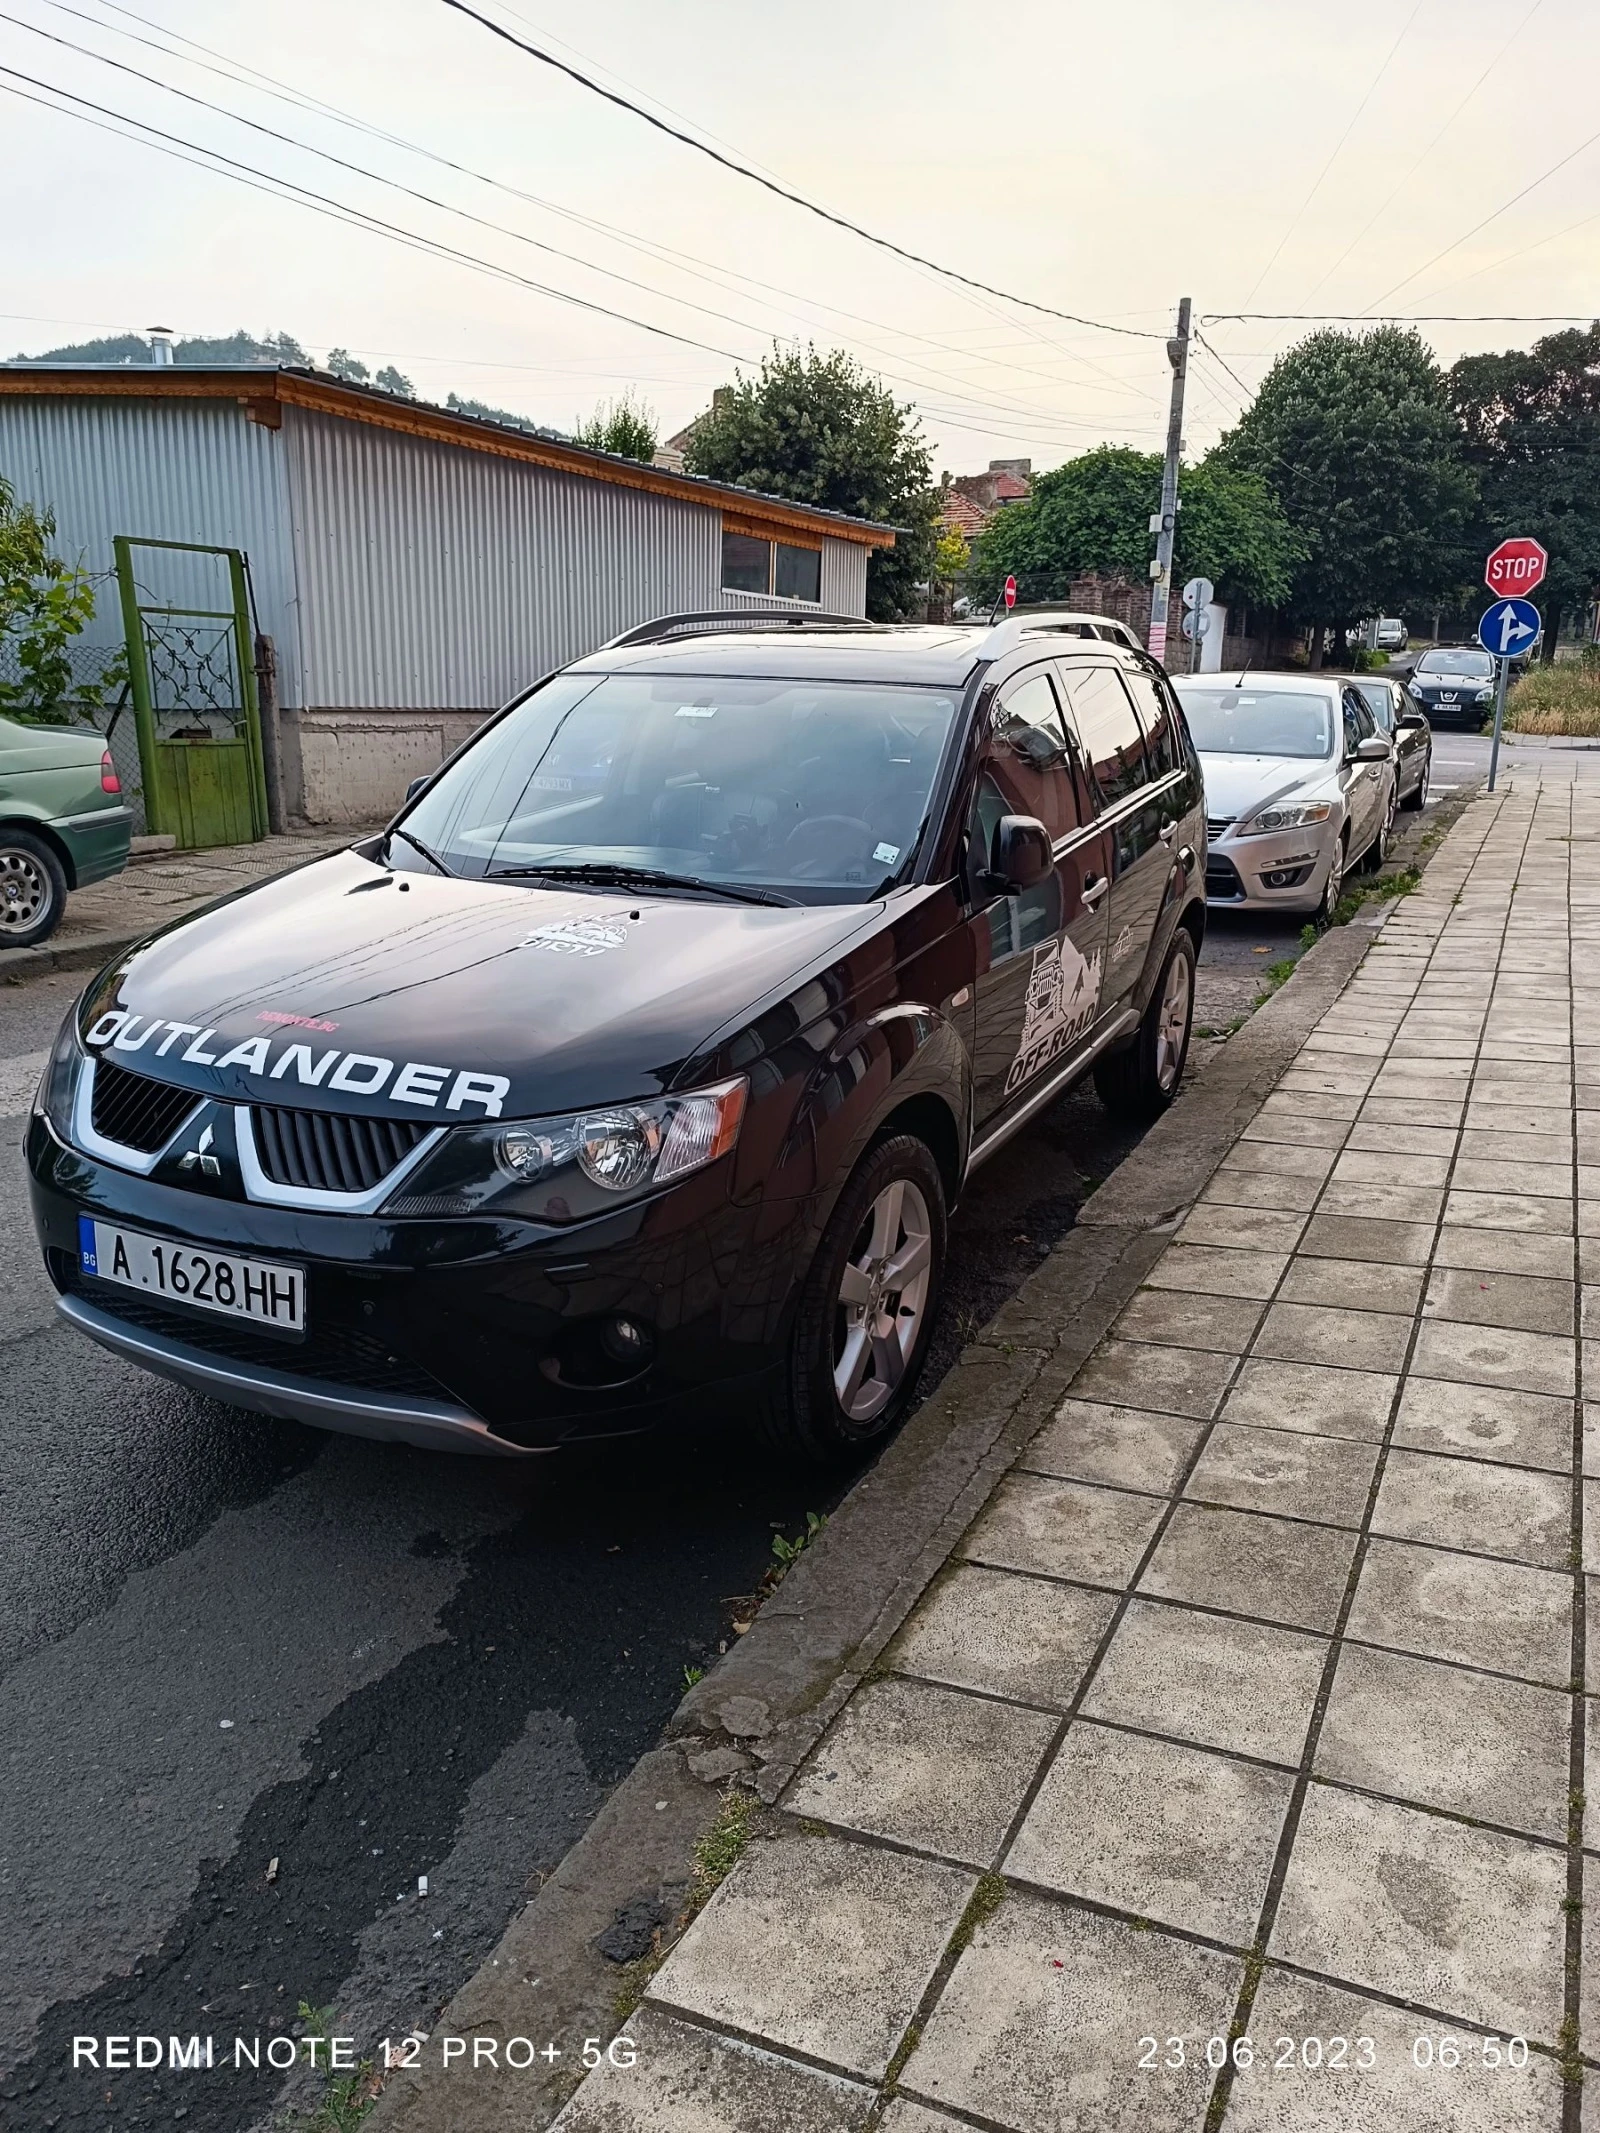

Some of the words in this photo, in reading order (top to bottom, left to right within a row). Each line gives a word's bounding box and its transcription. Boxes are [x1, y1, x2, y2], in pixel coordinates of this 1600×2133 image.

[1491, 556, 1540, 580] STOP
[516, 938, 607, 958] DIRTY
[1007, 1002, 1096, 1091] OFF-ROAD
[85, 1010, 511, 1117] OUTLANDER
[83, 1251, 97, 1266] BG
